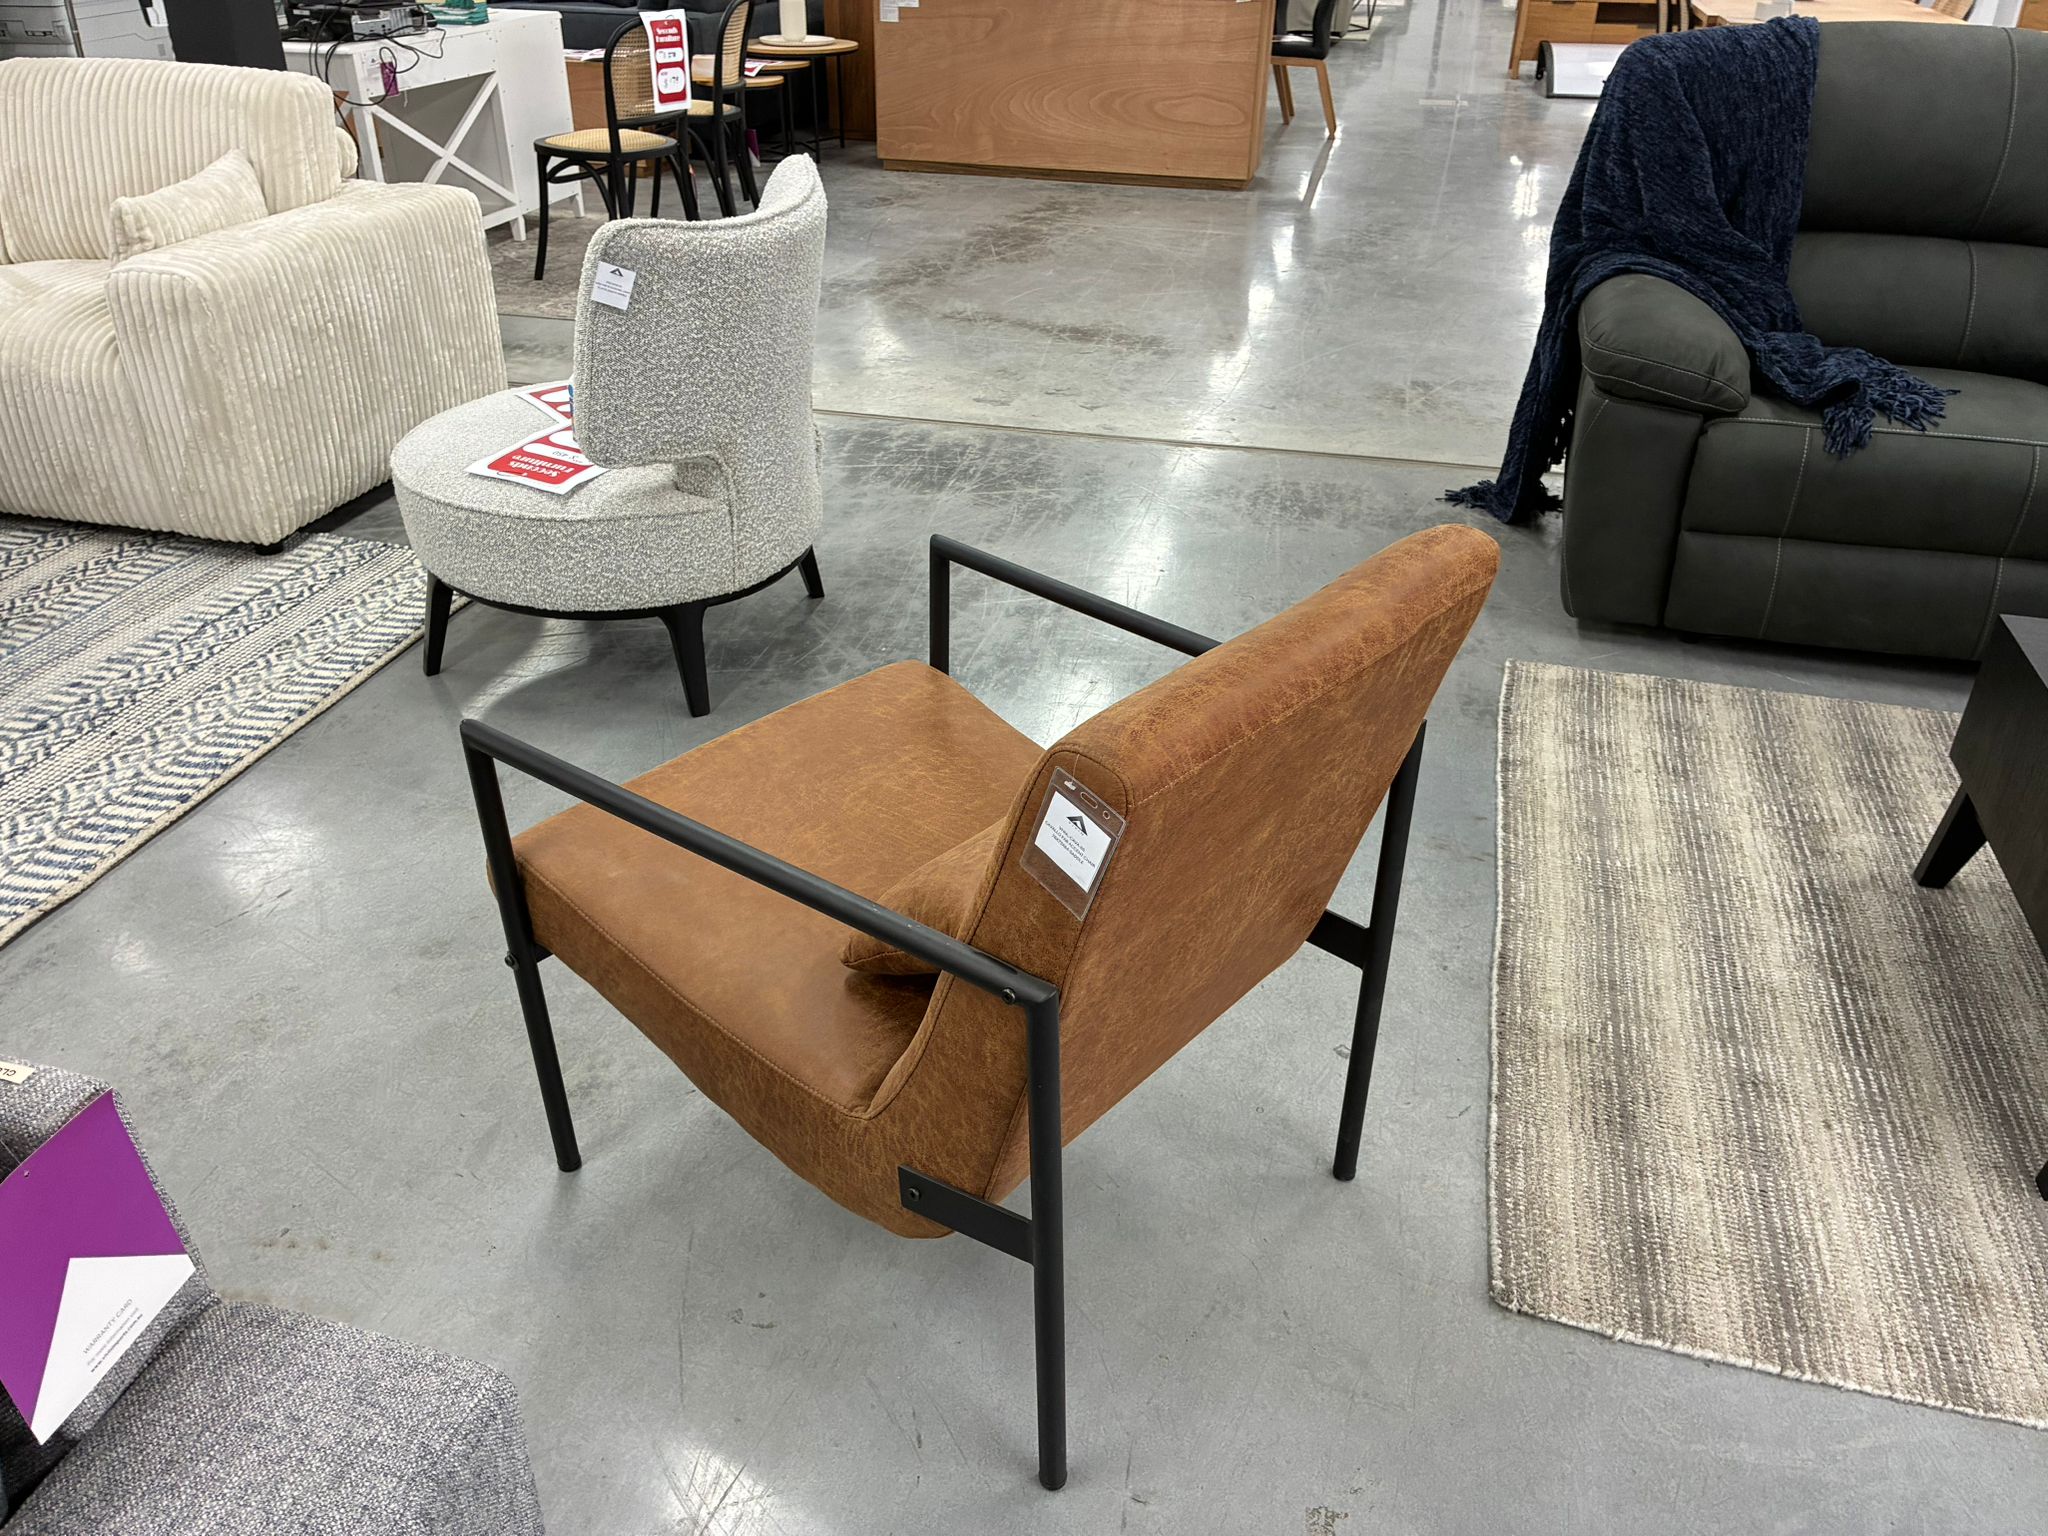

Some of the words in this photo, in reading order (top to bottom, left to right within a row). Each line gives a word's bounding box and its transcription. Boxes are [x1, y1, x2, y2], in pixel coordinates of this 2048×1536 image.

[509, 461, 559, 477] Seconds
[511, 455, 575, 473] Furniture
[83, 1316, 116, 1354] WARRANTY
[115, 1298, 133, 1319] CARD
